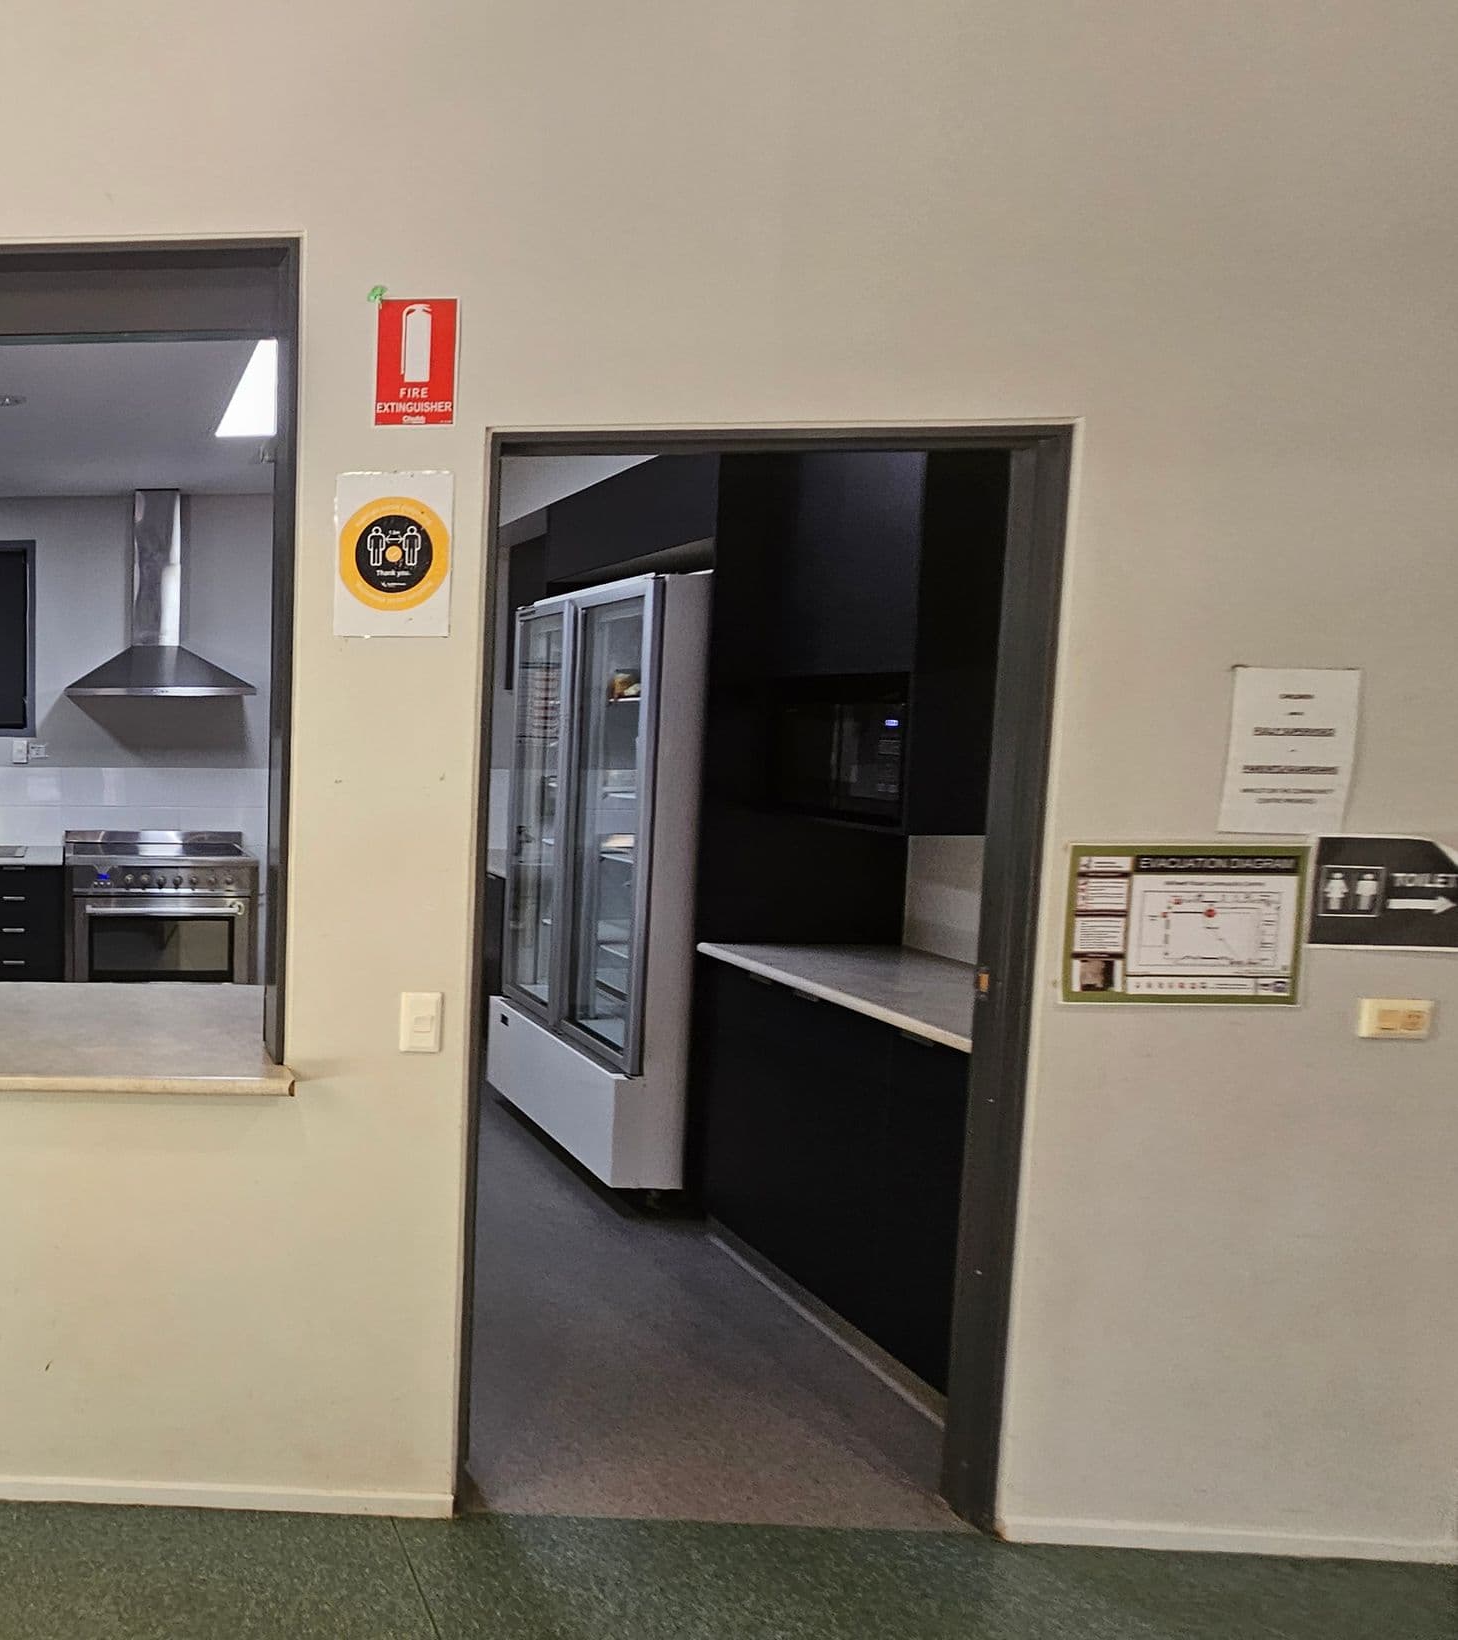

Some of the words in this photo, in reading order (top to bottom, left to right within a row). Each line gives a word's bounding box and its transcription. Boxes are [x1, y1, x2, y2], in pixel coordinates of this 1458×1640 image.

[399, 387, 429, 399] FIRE
[376, 401, 452, 413] EXTINGUISHER
[1139, 857, 1225, 869] EVACUATION
[1229, 857, 1297, 869] DIAGRAM
